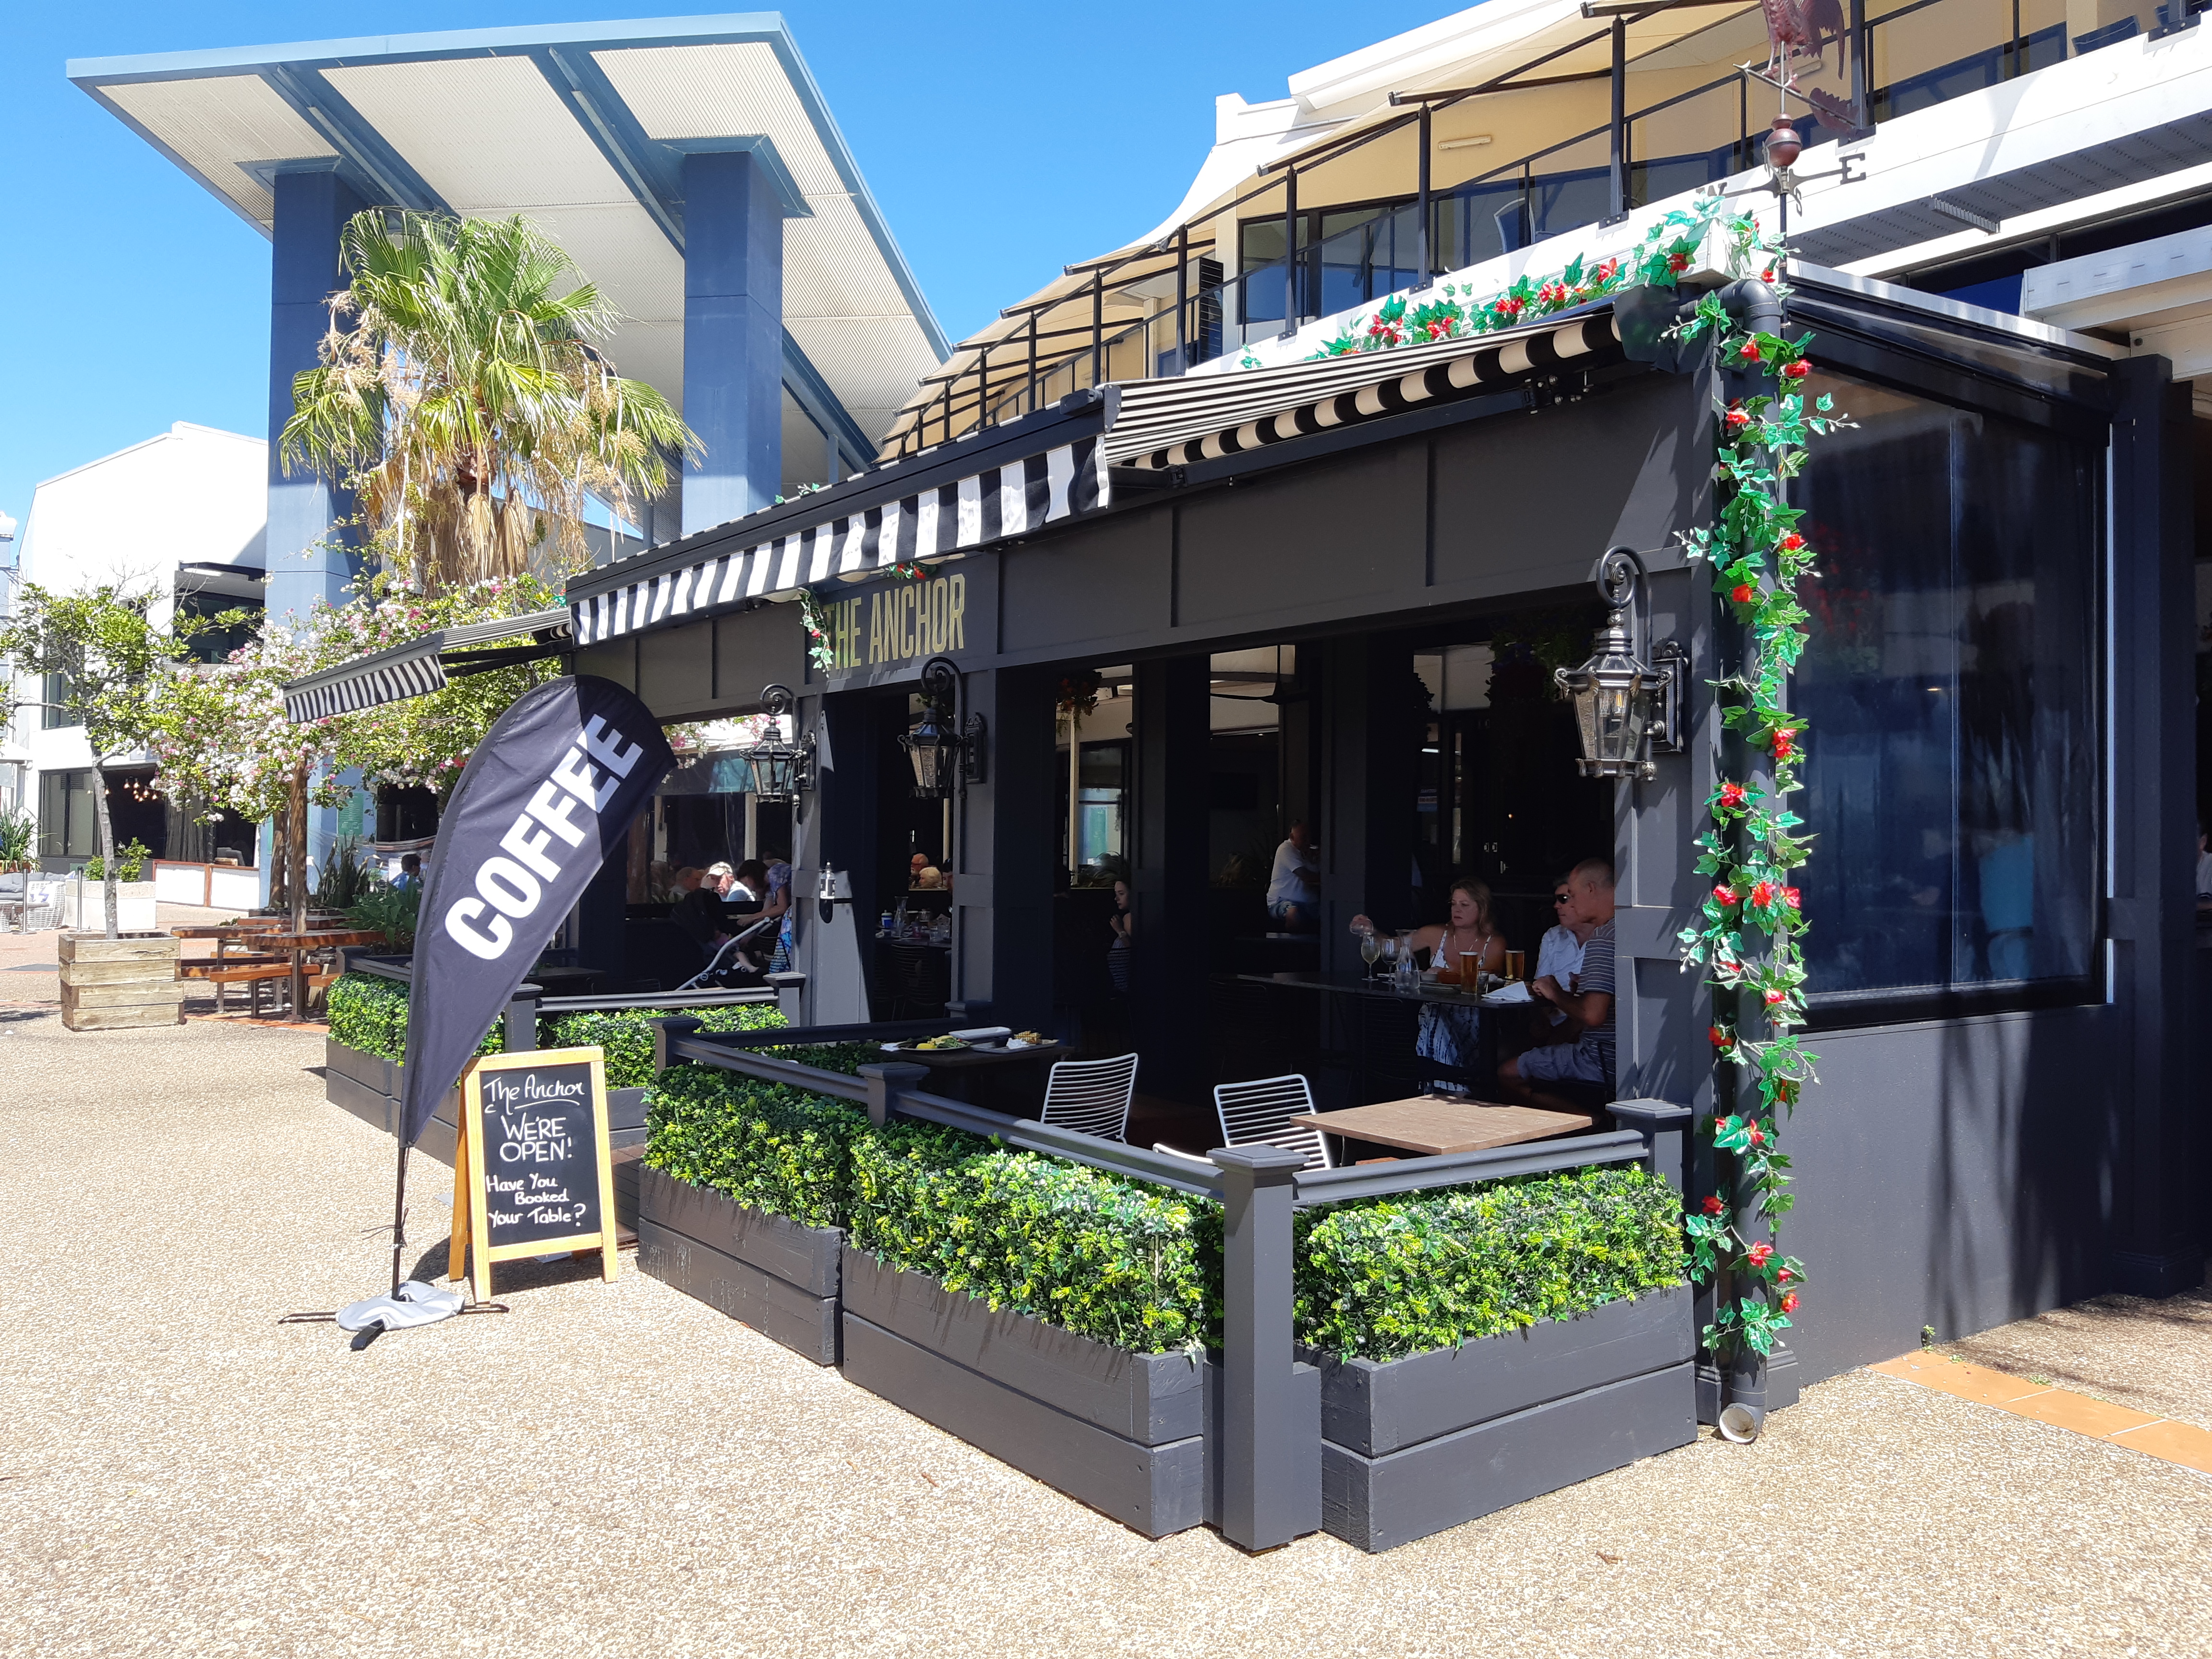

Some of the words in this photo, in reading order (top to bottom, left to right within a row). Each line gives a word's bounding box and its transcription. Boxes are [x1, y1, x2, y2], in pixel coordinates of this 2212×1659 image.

[869, 573, 965, 664] ANCHOR
[445, 713, 643, 960] COFFEE
[483, 1076, 520, 1115] The
[524, 1074, 585, 1099] Anchor
[501, 1112, 566, 1141] WE'RE
[500, 1137, 572, 1162] OPEN!
[486, 1175, 524, 1192] Have
[529, 1173, 558, 1190] You
[515, 1188, 570, 1205] Booked
[488, 1210, 523, 1228] Your
[527, 1203, 586, 1226] Table?
